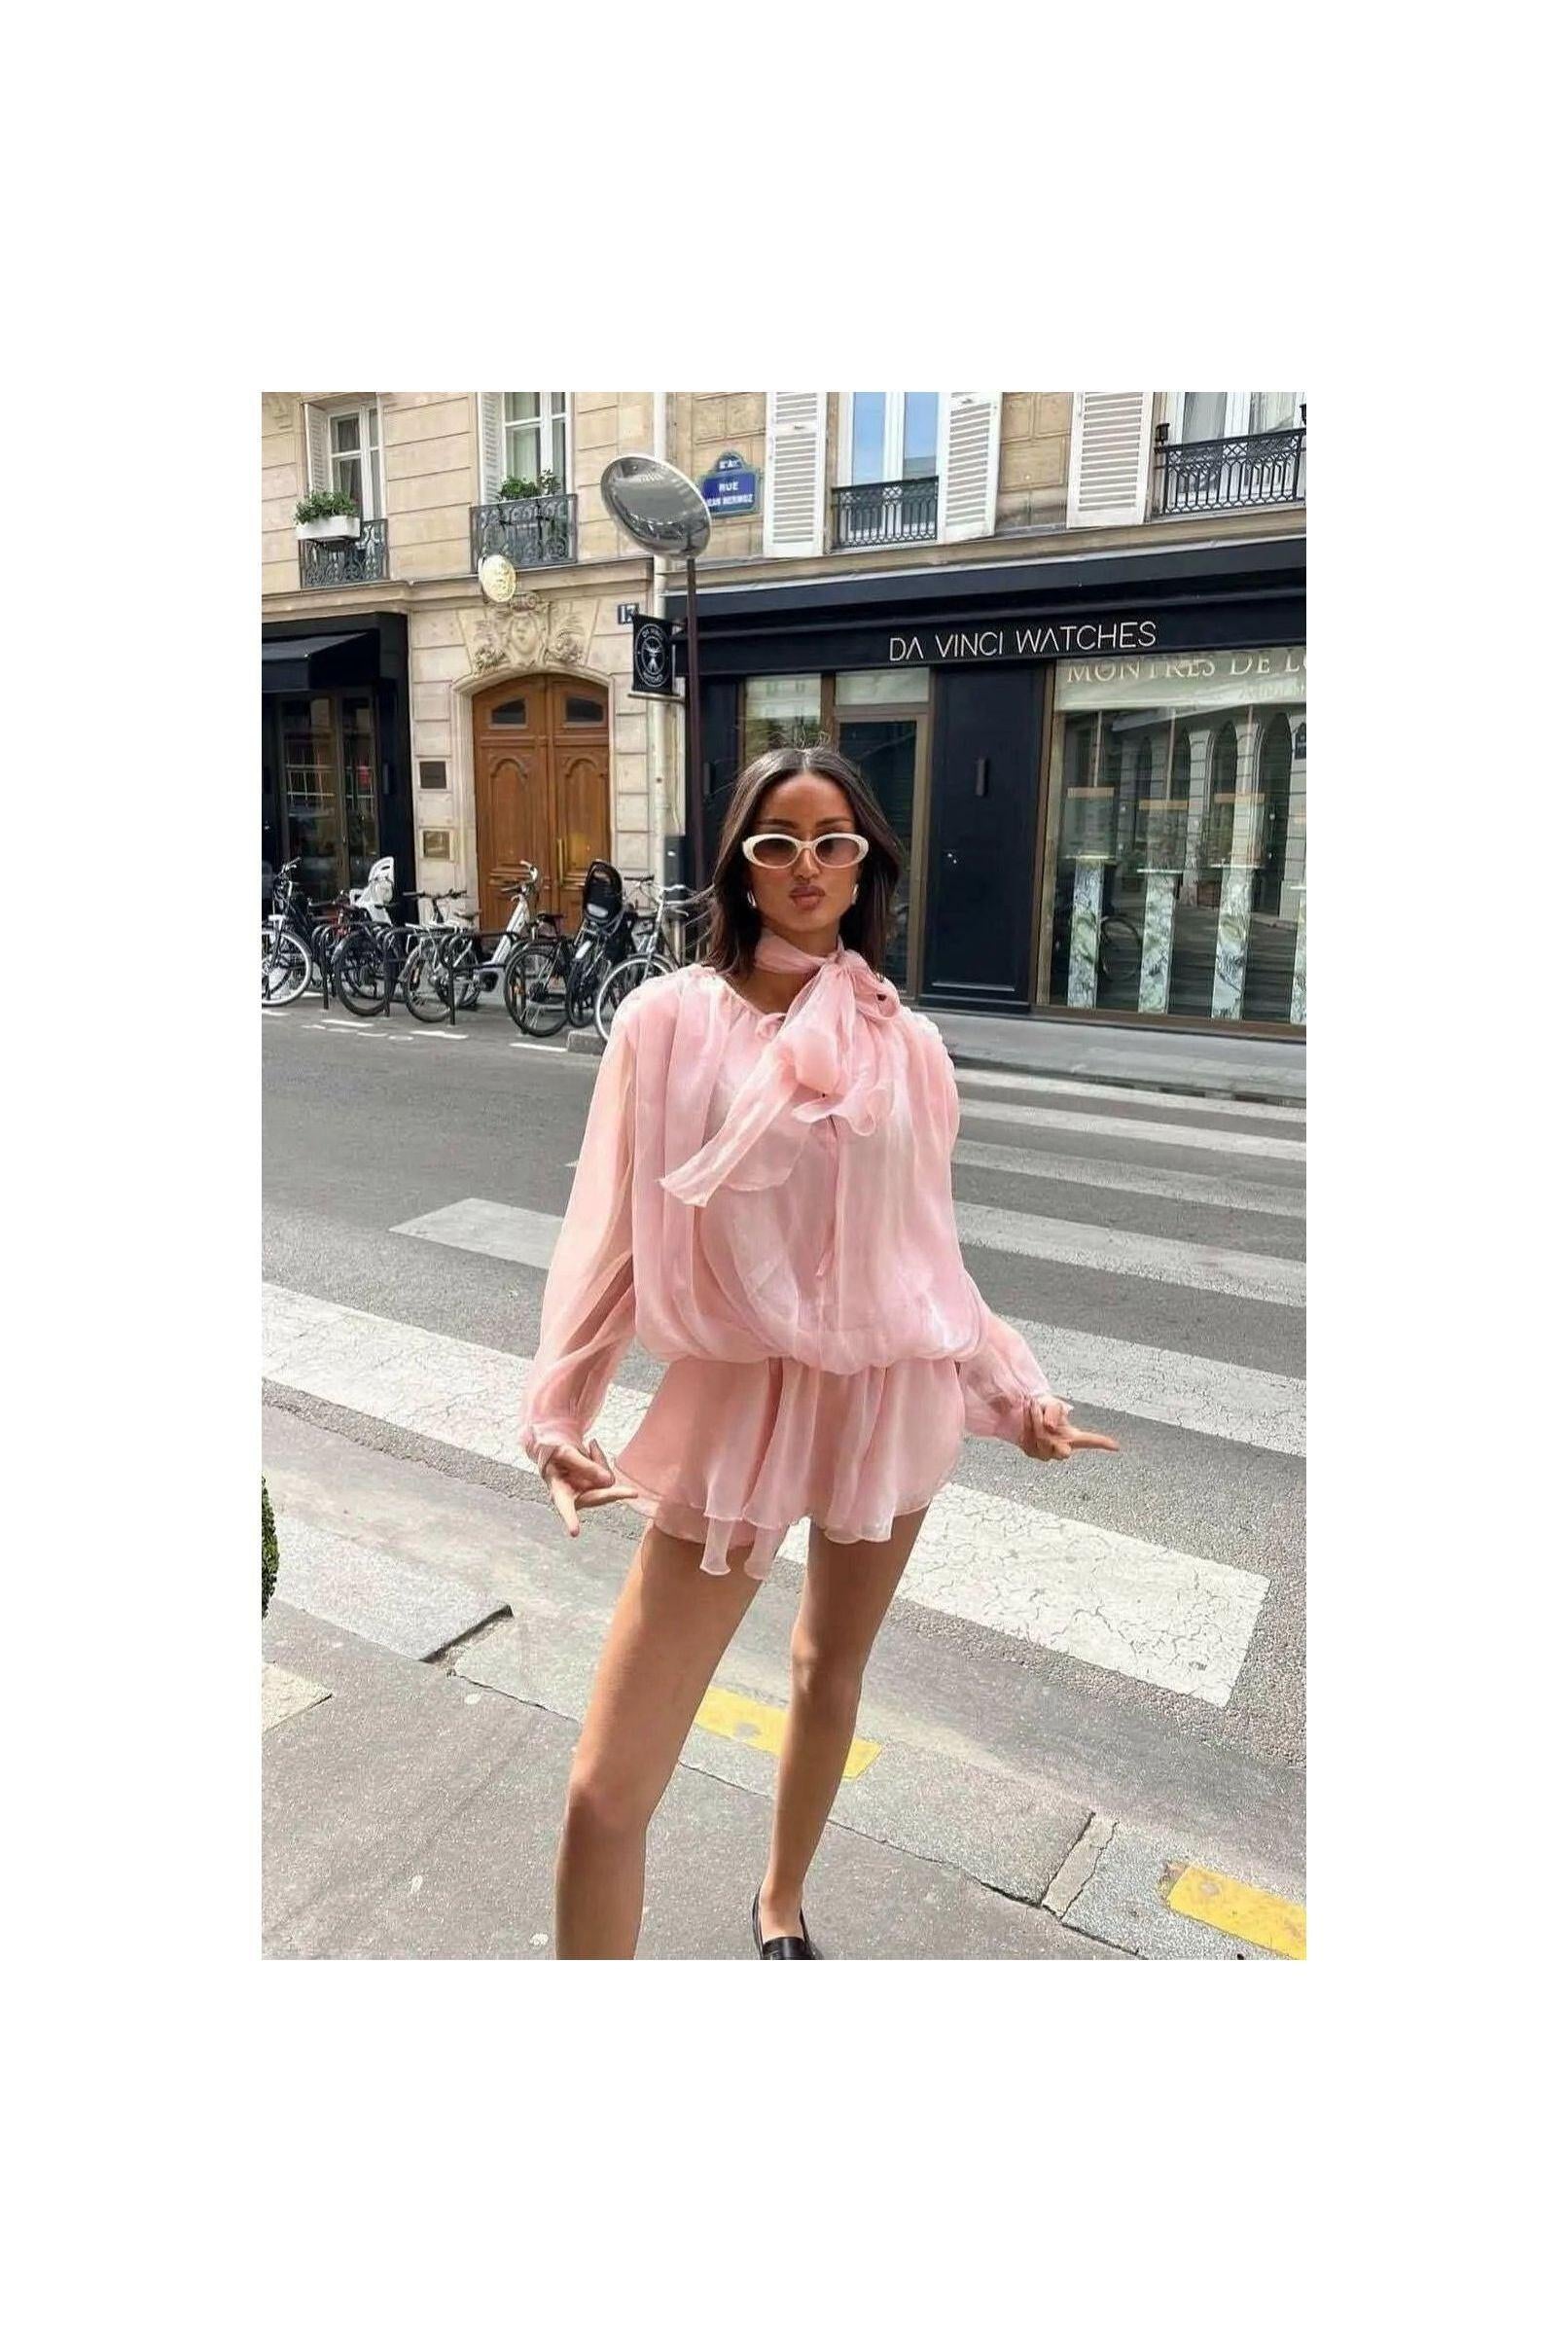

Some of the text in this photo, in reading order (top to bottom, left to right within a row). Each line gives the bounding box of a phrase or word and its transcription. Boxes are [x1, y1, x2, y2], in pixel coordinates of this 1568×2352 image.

[719, 481, 739, 492] RUE
[889, 621, 1157, 661] DA VINCI WATCHES
[1229, 653, 1270, 676] DE
